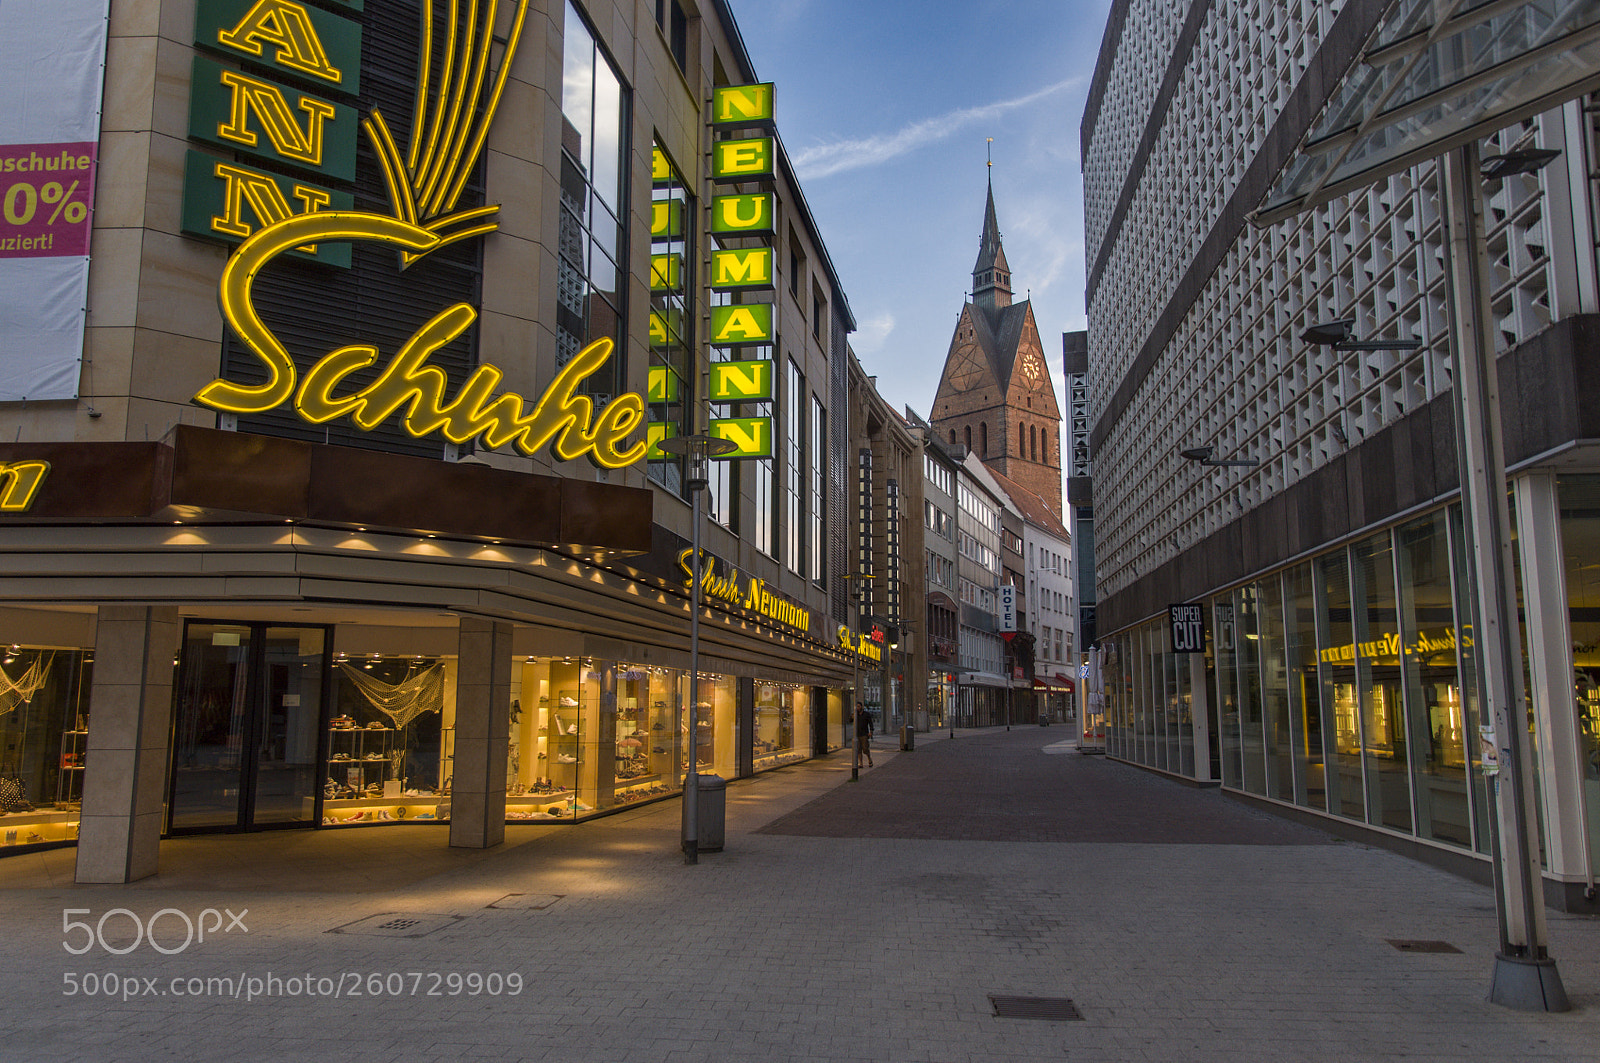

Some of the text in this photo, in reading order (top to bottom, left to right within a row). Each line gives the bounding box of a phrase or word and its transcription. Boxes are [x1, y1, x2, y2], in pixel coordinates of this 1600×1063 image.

[0, 151, 90, 172] schuhe
[715, 87, 767, 454] NEUMANN
[192, 210, 648, 468] Schuhe
[1003, 589, 1012, 629] HOTEL
[1172, 606, 1200, 621] SUPER
[1173, 621, 1202, 650] CUT
